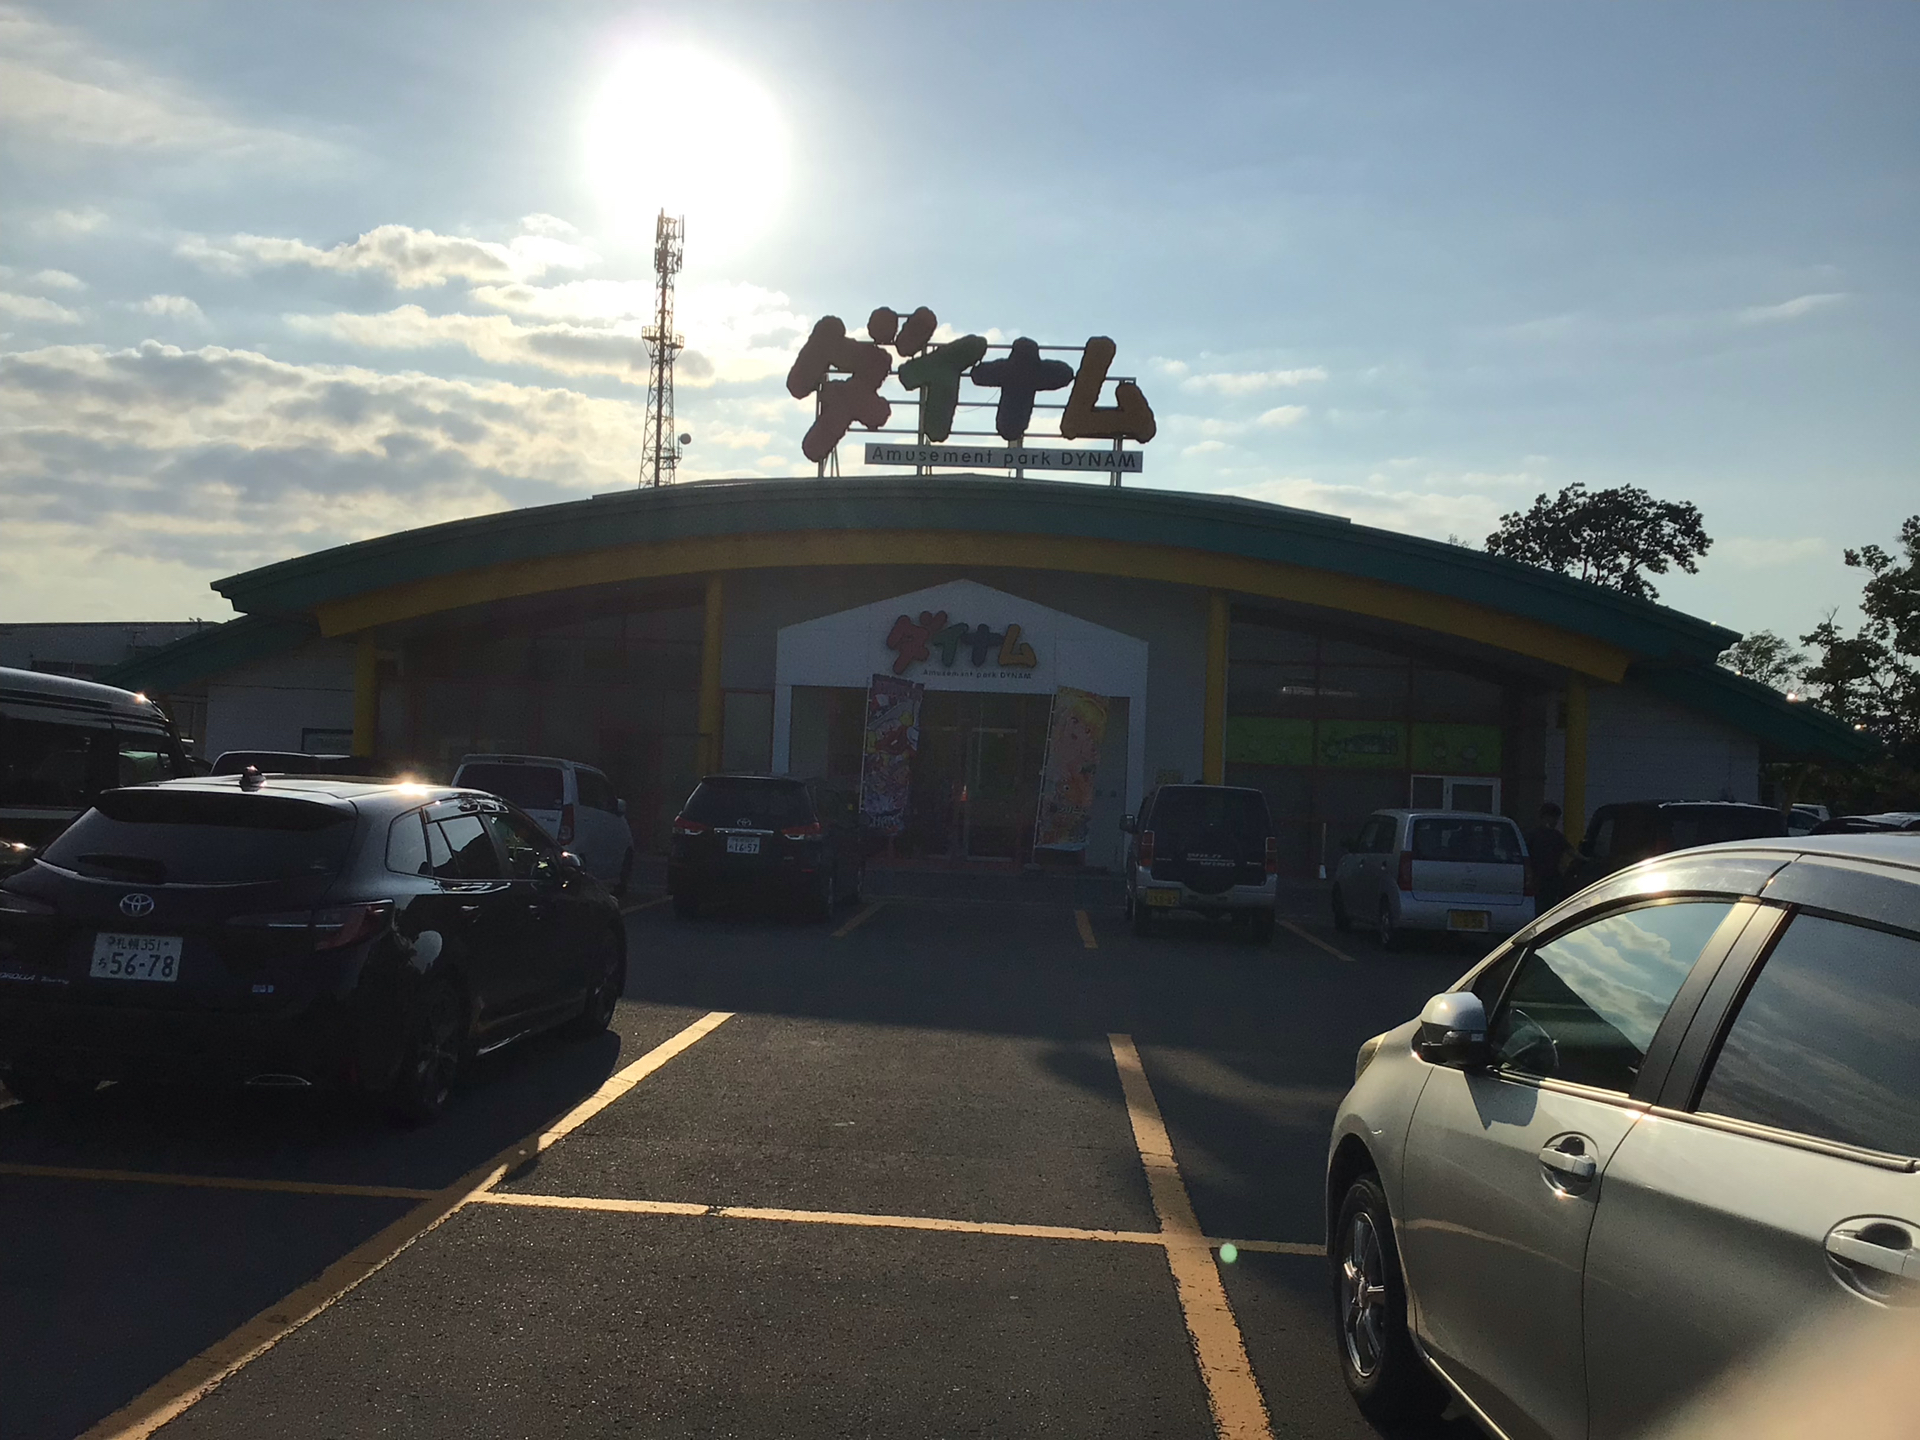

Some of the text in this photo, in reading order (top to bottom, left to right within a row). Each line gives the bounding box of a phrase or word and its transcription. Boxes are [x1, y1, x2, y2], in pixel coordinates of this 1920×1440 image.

[787, 306, 1156, 462] ダイナム
[872, 447, 1136, 468] Amusement park DYNAM
[888, 610, 1037, 674] ダイナム
[923, 669, 1031, 681] Amusement park DYNAM
[109, 952, 174, 977] 56-78
